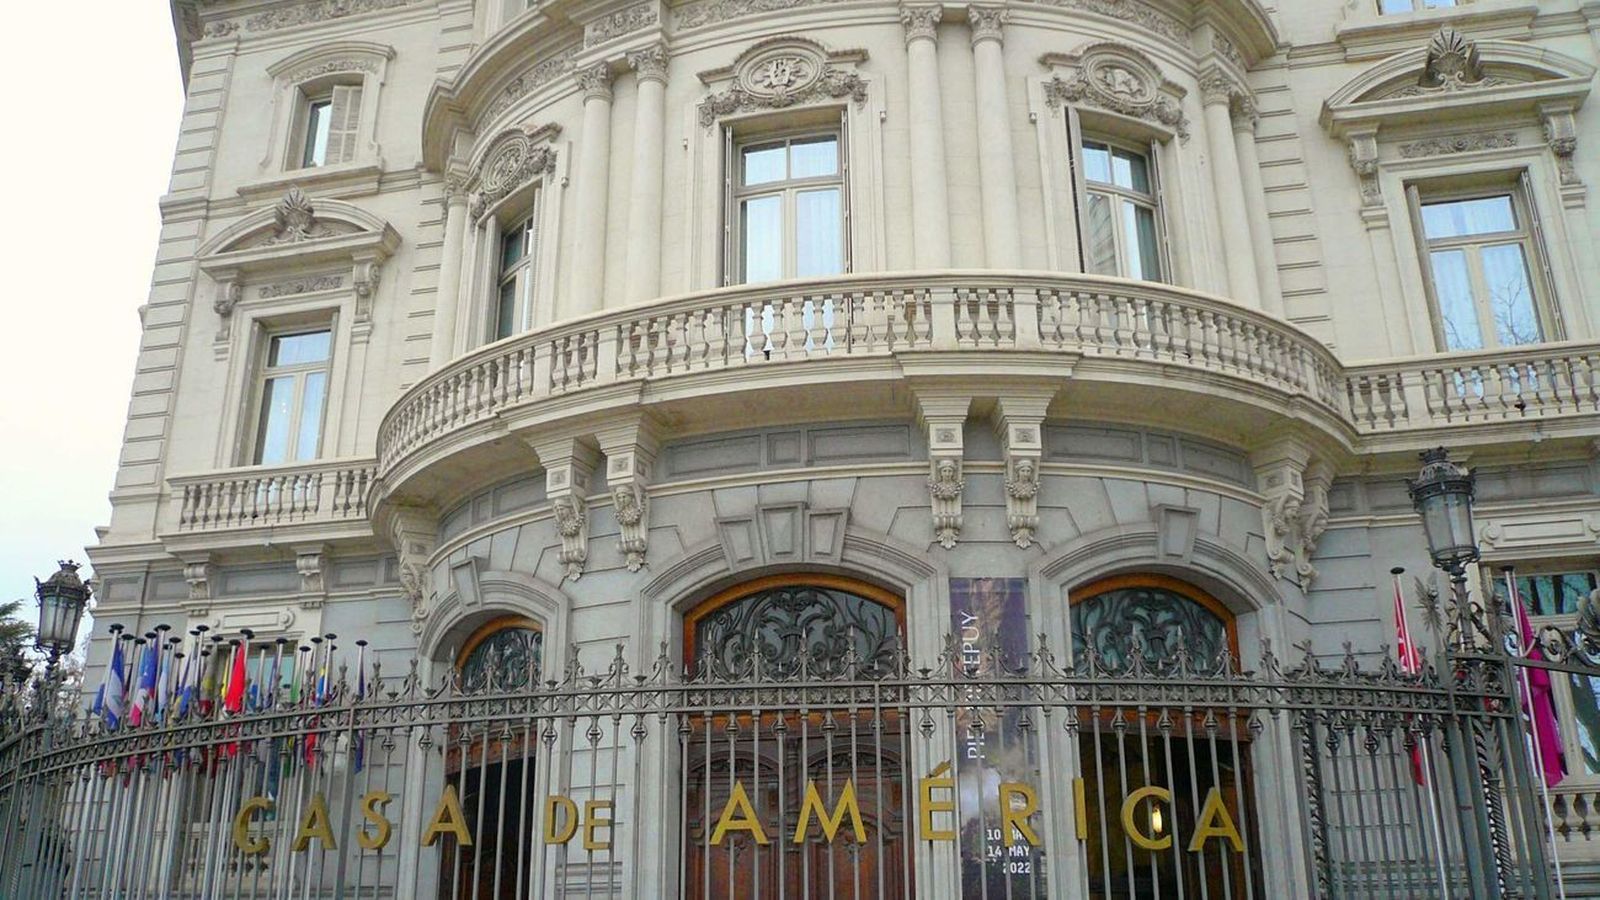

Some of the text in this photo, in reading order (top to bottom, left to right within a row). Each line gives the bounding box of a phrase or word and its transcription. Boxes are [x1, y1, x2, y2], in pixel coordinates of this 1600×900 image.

[234, 760, 1244, 854] CASA DE AMÉRICA
[986, 829, 1001, 840] 10
[987, 845, 1030, 857] 14 MAY
